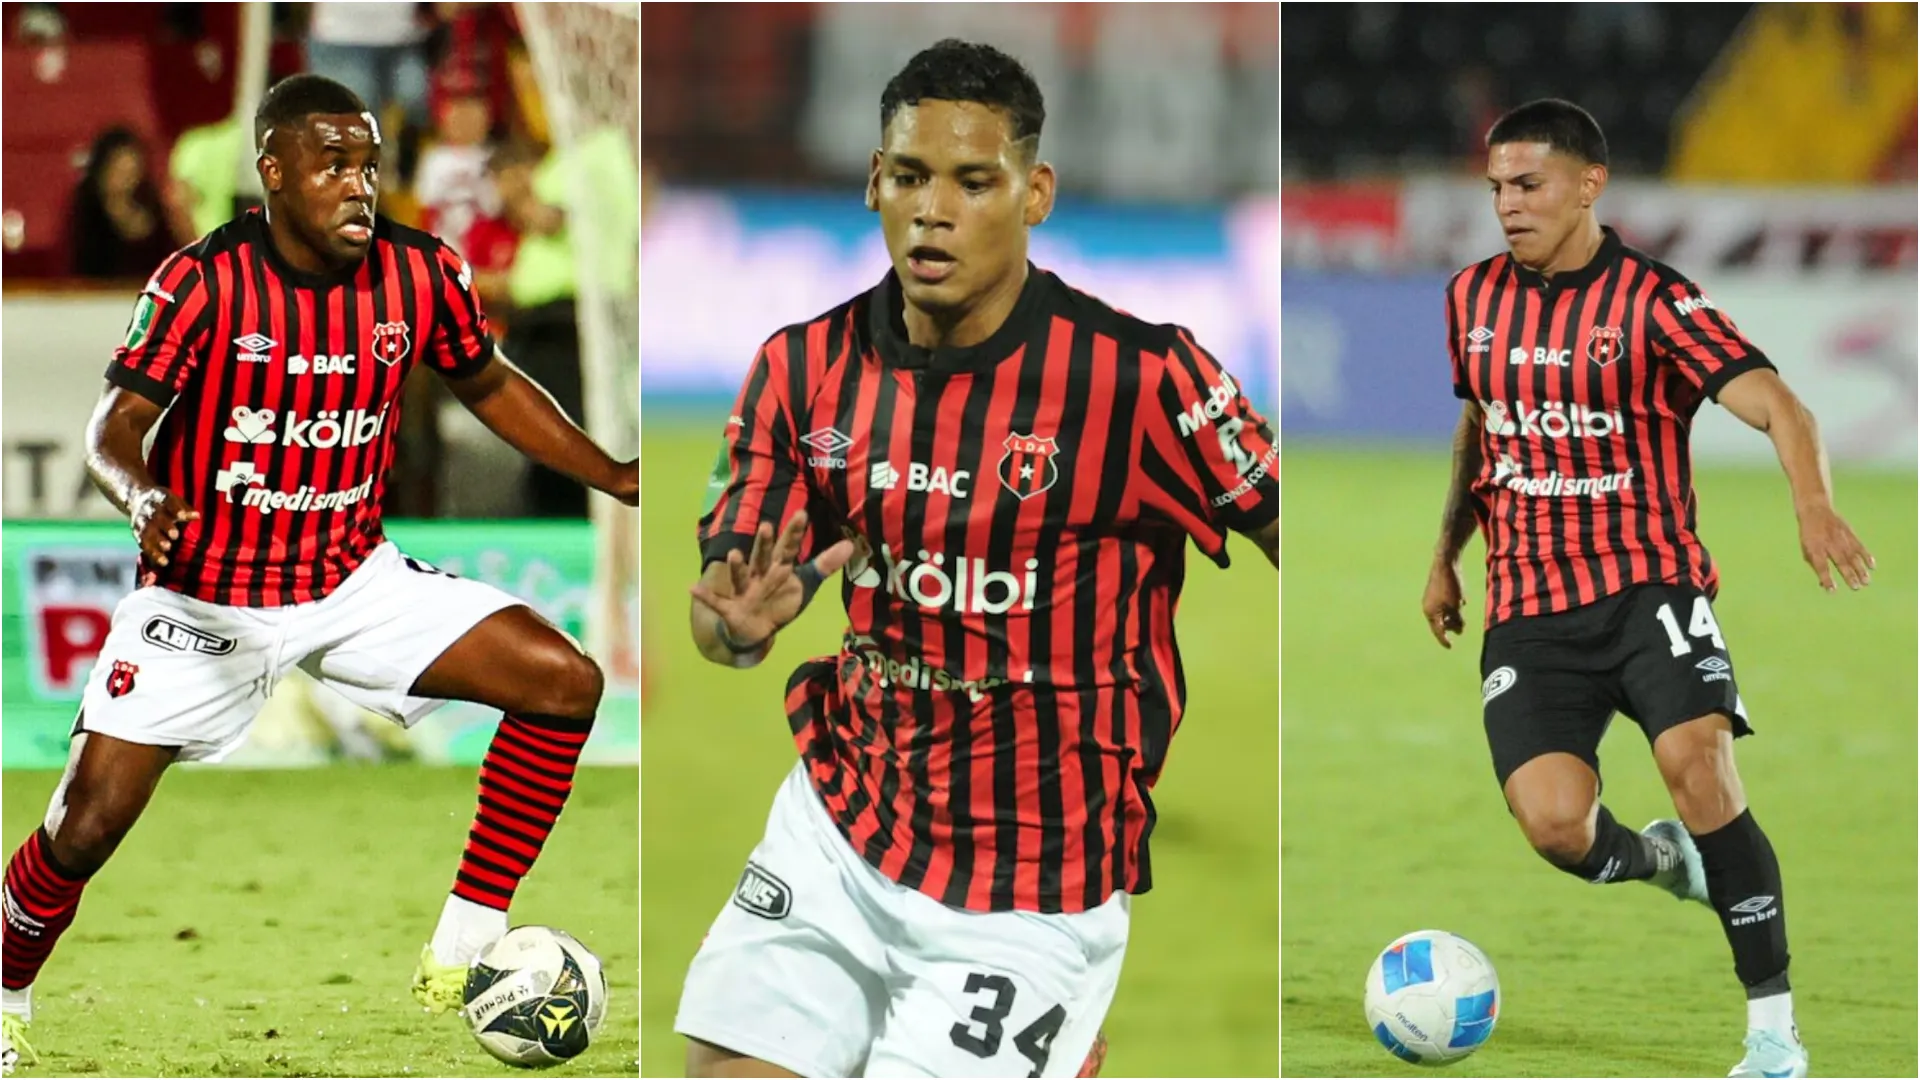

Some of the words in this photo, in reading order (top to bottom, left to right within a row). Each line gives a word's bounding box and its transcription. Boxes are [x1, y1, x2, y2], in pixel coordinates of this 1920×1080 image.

[236, 352, 272, 364] umbro
[313, 354, 356, 375] BAC
[1533, 346, 1573, 367] BAC
[1176, 369, 1239, 438] Mobil
[1515, 400, 1625, 438] kölbi
[282, 401, 390, 449] kölbi
[1013, 440, 1047, 453] LDA
[241, 473, 374, 514] medismart
[906, 462, 971, 498] BAC
[1507, 468, 1635, 499] medismart
[881, 543, 1039, 615] kölbi
[1655, 595, 1727, 658] 14
[1731, 907, 1777, 926] umbro
[949, 972, 1067, 1078] 34
[1395, 1011, 1429, 1042] molten
